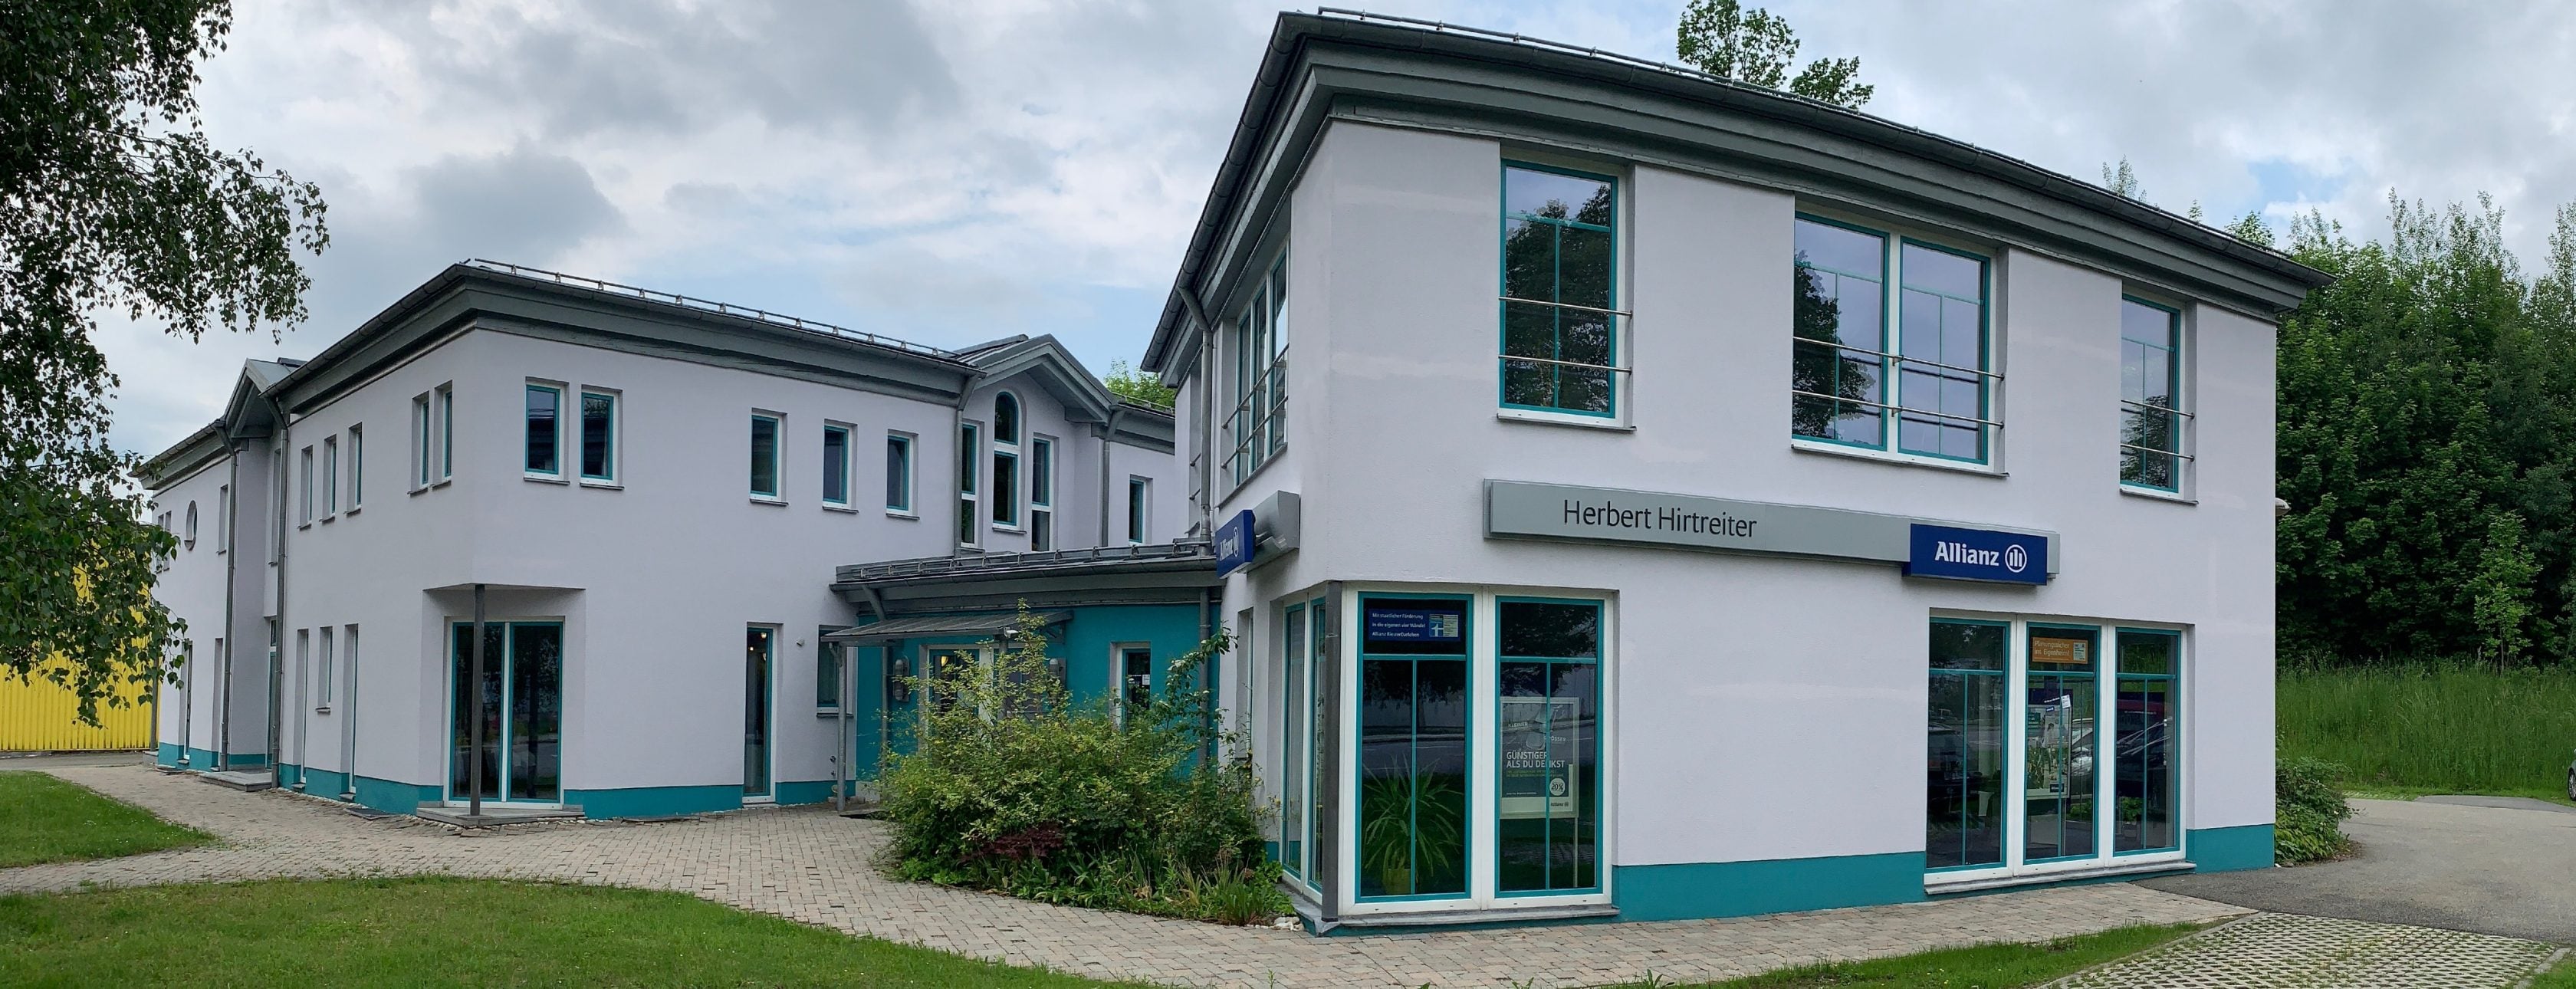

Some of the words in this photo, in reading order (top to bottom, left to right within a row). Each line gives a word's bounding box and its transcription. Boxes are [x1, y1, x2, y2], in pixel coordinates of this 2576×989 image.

[1564, 499, 1652, 529] Herbert
[1658, 506, 1757, 537] Hirtreiter
[1934, 540, 1999, 566] Allianz
[1506, 760, 1521, 768] ALS
[1523, 760, 1533, 768] DU
[1551, 783, 1564, 791] 20%
